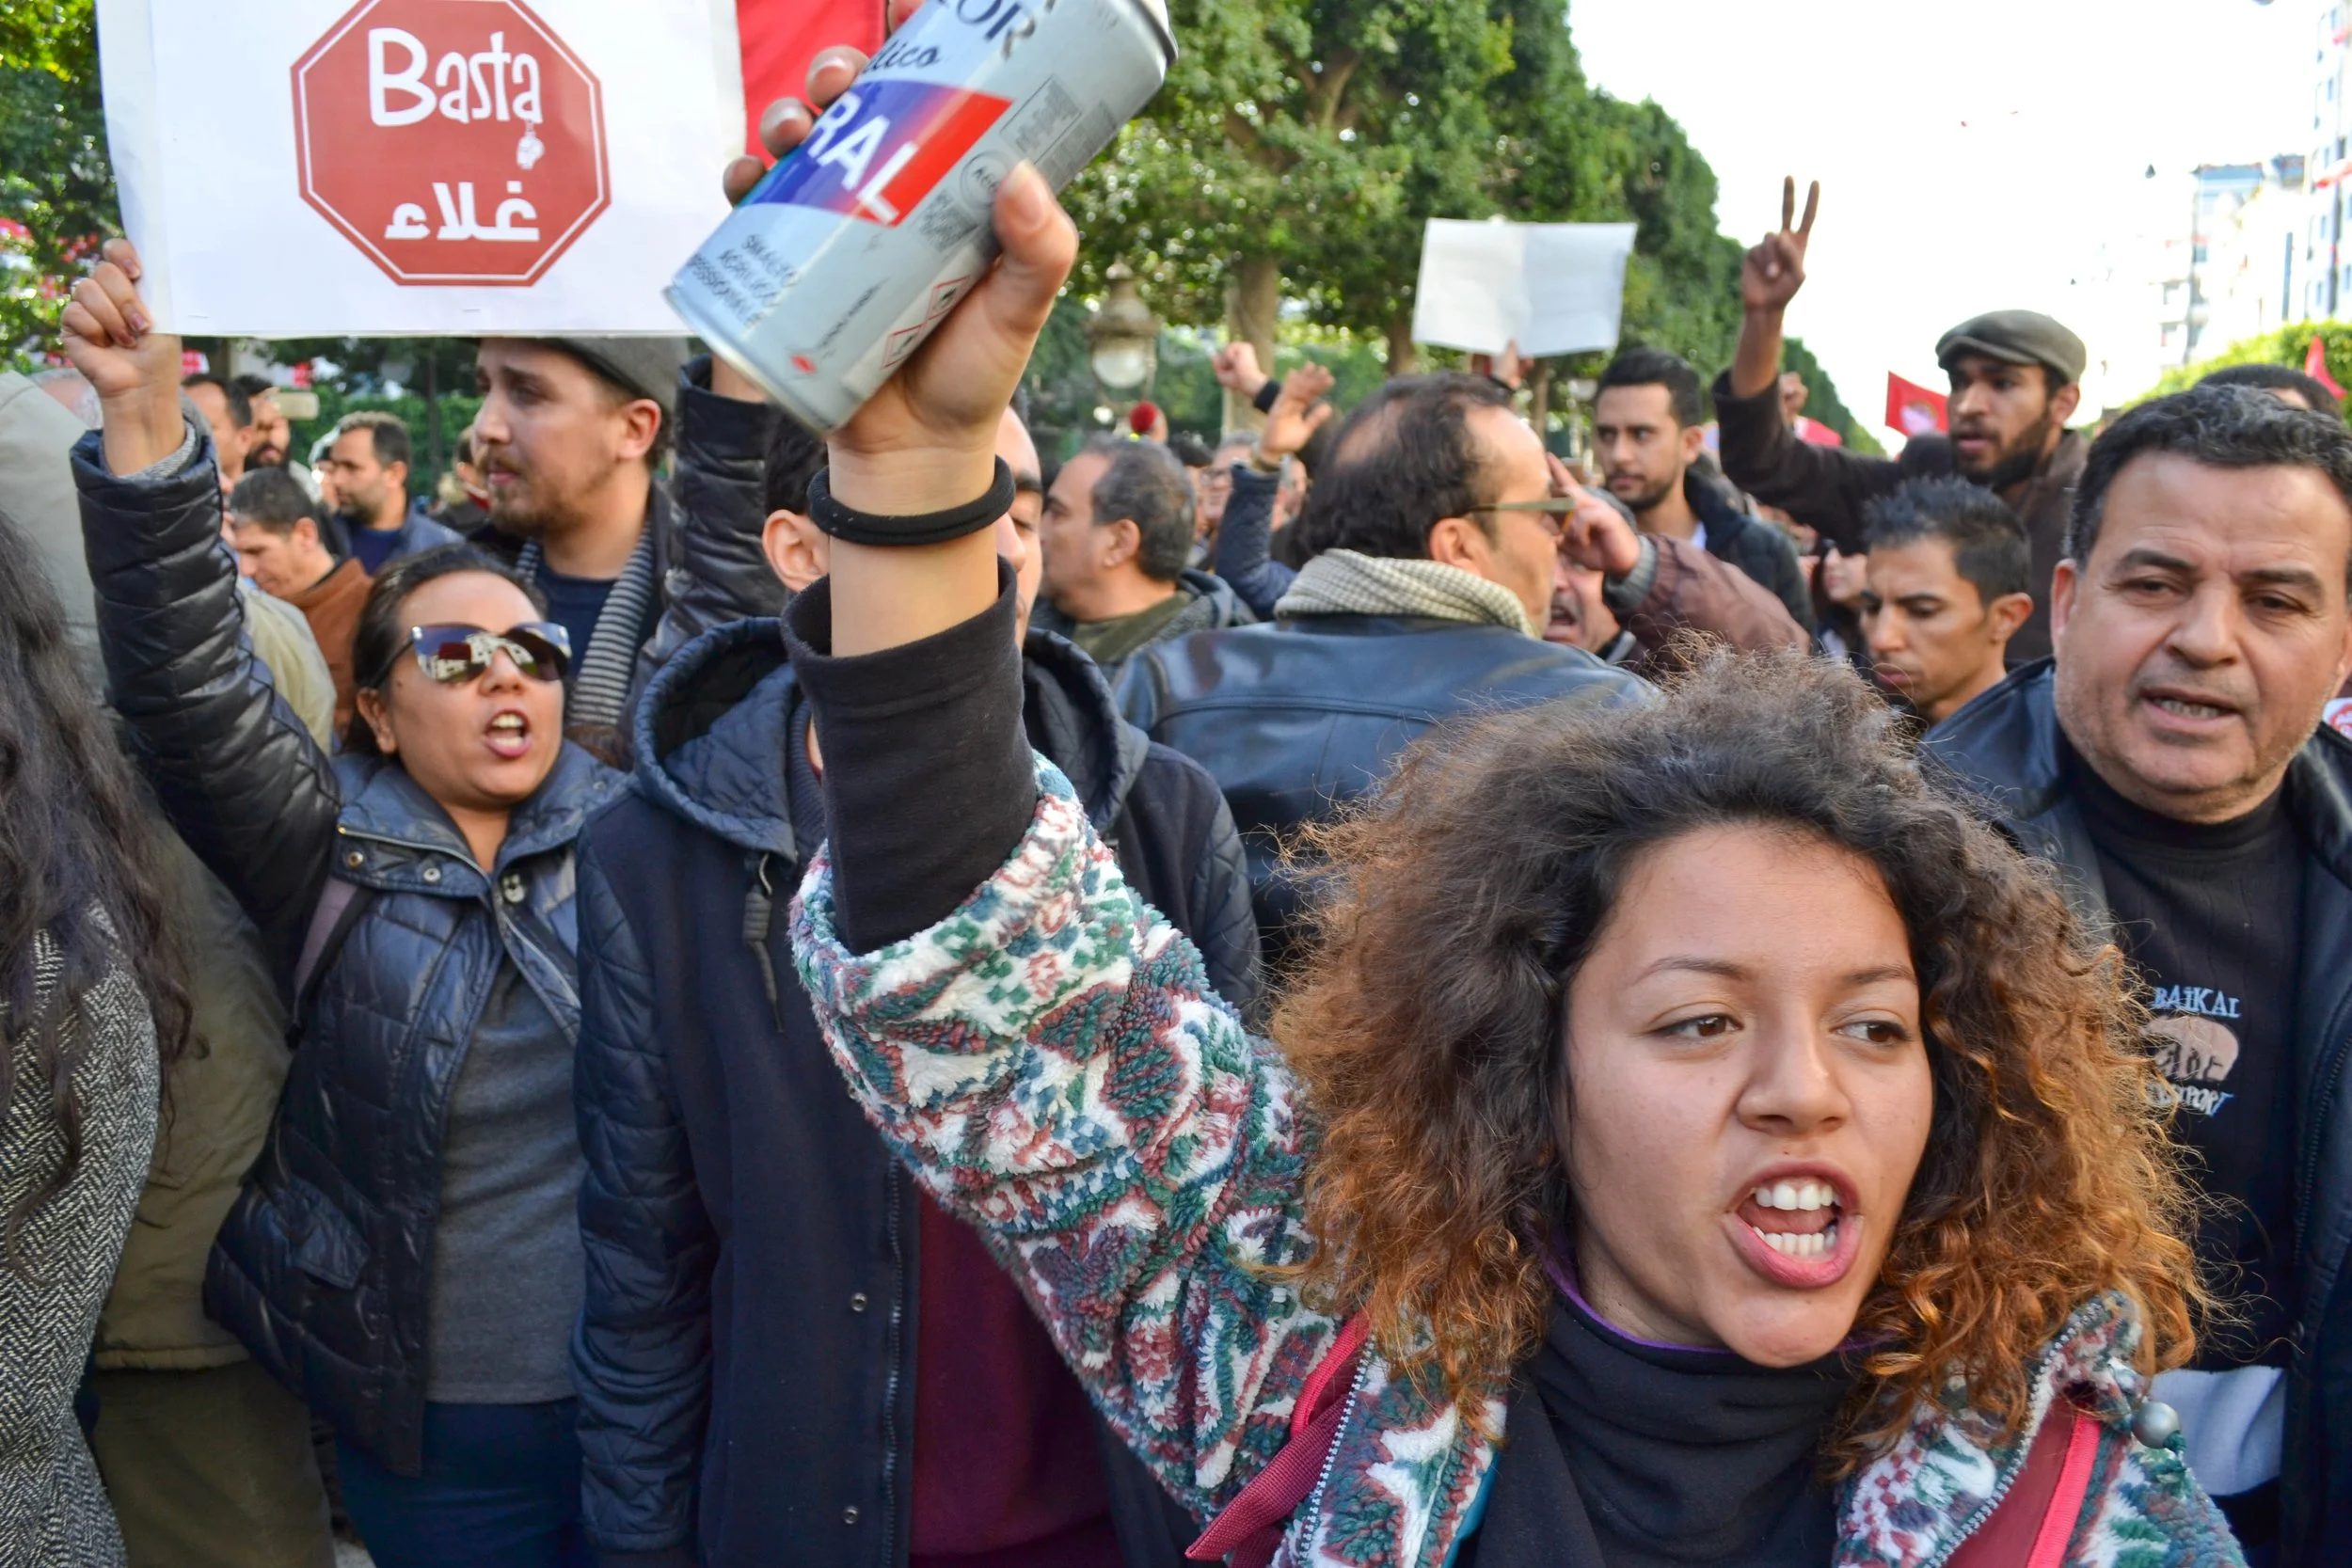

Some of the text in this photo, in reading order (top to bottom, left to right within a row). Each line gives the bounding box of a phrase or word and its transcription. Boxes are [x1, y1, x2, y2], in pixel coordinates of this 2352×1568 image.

[937, 0, 1036, 62] OR
[368, 27, 543, 126] Basta
[806, 91, 920, 225] RAL
[384, 180, 540, 242] غلاء
[2149, 984, 2242, 1019] BAIKAL
